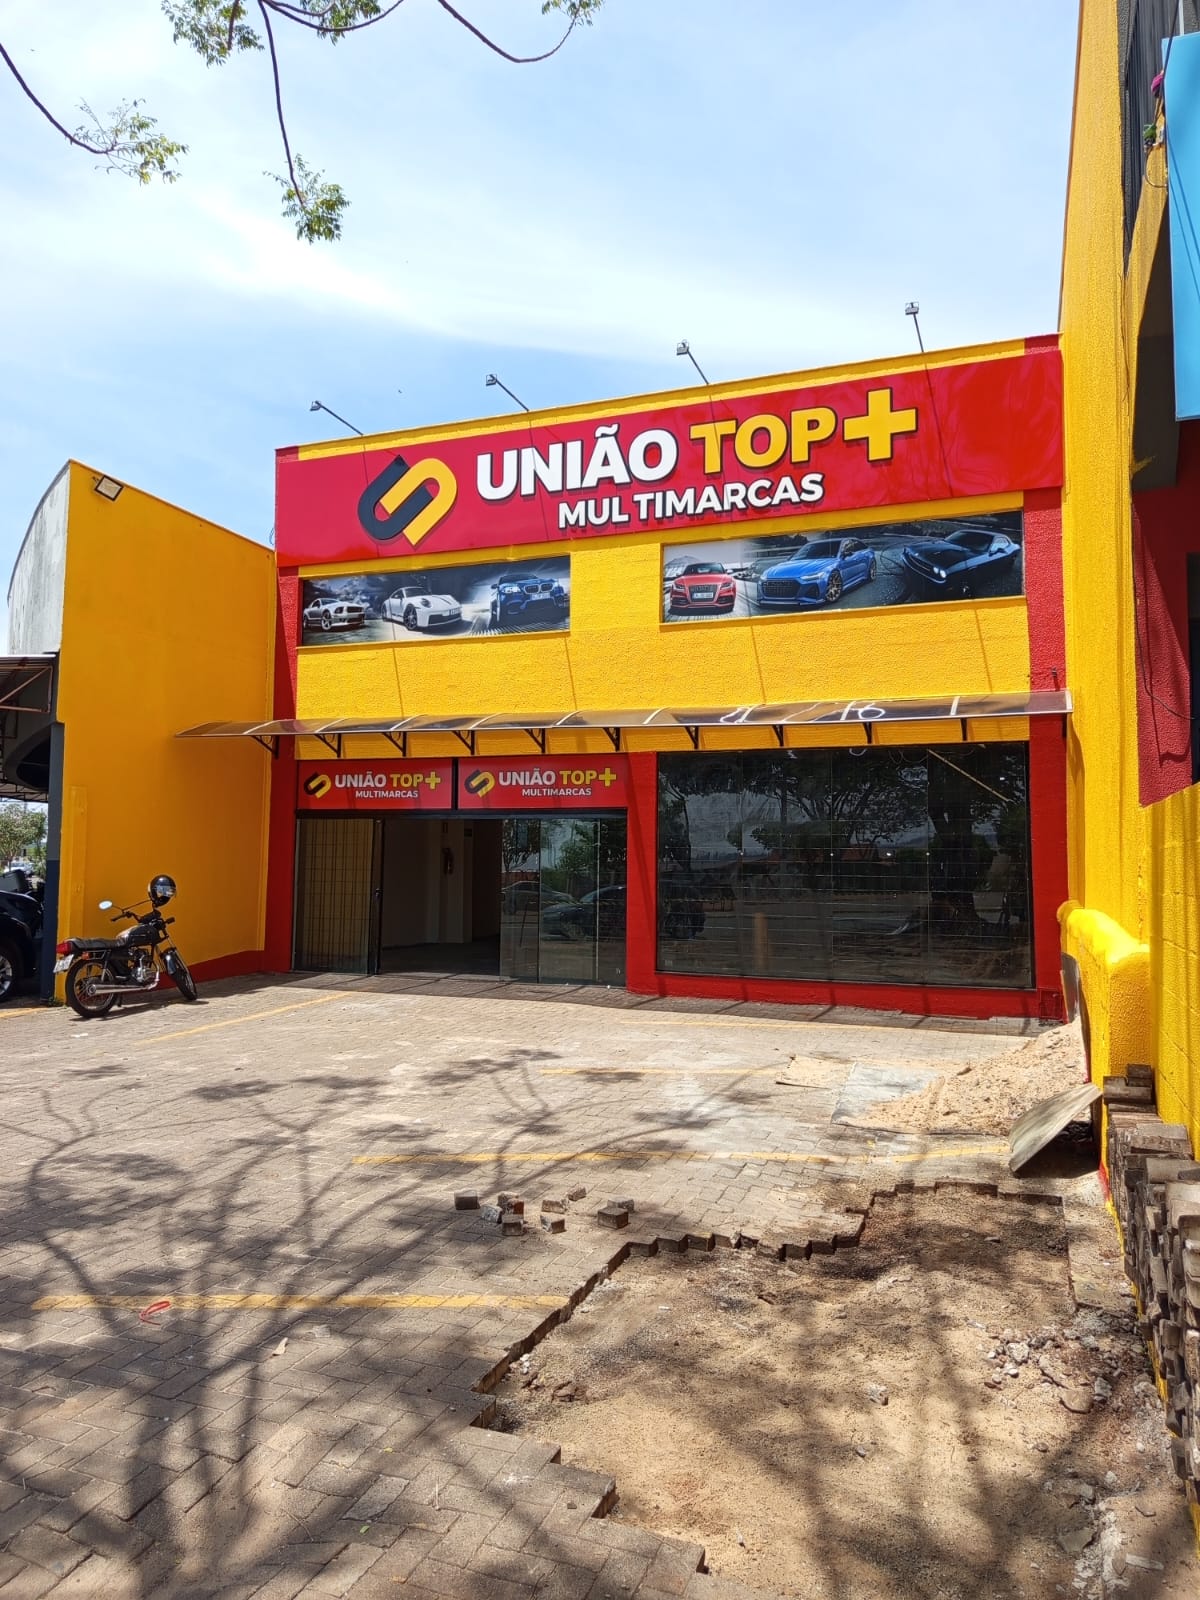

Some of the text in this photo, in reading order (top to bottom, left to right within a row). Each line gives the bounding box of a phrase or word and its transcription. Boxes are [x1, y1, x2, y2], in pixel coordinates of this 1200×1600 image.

[476, 423, 679, 501] UNIÃO
[335, 771, 386, 788] UNIÃO
[499, 768, 556, 786] UNIÃO
[355, 790, 418, 798] MULTIMARCAS
[522, 788, 592, 796] MULTIMARCAS
